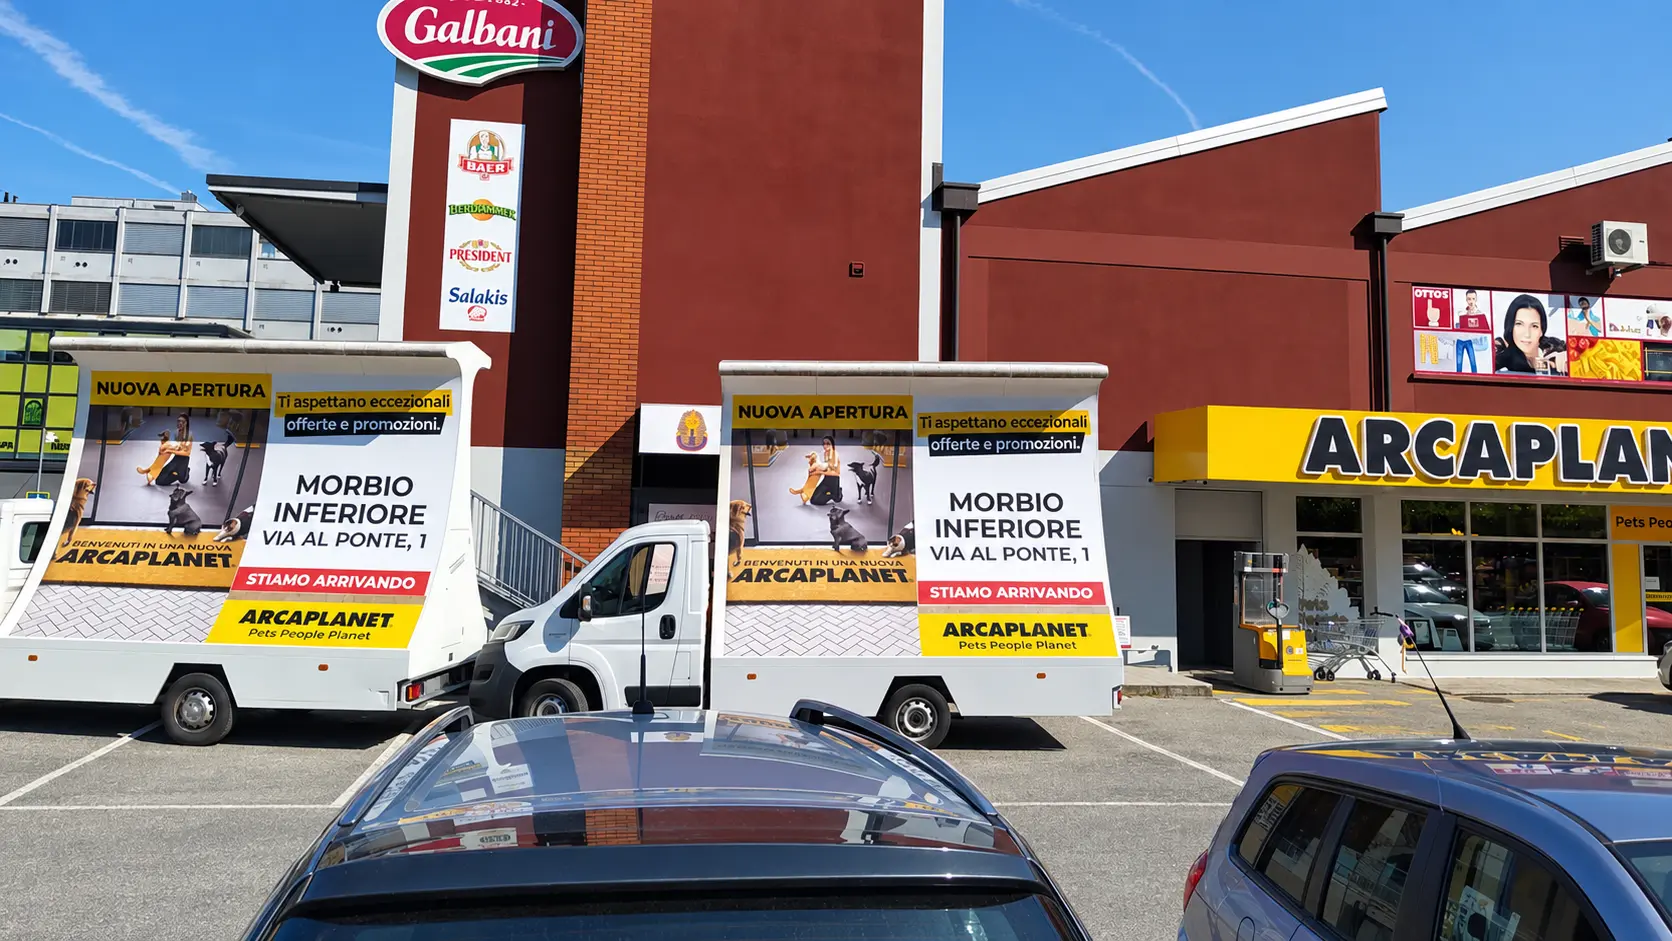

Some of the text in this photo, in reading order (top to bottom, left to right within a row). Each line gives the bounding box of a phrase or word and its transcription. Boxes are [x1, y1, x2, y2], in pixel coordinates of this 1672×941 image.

[405, 6, 556, 50] Galbani
[467, 161, 505, 173] BAER
[449, 248, 512, 263] PRESIDENT
[448, 287, 508, 305] Salakis
[97, 381, 266, 398] NUOVA APERTURA
[277, 394, 450, 411] Ti aspettano eccezionali
[738, 405, 908, 419] NUOVA APERTURA
[286, 416, 441, 434] offerte e promozioni.
[920, 415, 1088, 431] Ti aspettano eccezionali
[931, 436, 1081, 453] offerte e promozioni.
[296, 474, 414, 497] MORBIO
[950, 492, 1064, 513] MORBIO
[273, 502, 427, 525] INFERIORE
[1616, 516, 1645, 528] Pets
[935, 519, 1082, 539] INFERIORE
[72, 540, 140, 549] BENVENUTI
[159, 543, 185, 551] UNA
[187, 544, 233, 552] NUOVA
[263, 530, 427, 551] VIA AL PONTE, 1
[55, 549, 232, 568] ARCAPLANET
[744, 559, 813, 567] BENVENUTI
[816, 559, 829, 567] IN
[860, 560, 905, 568] NUOVA
[930, 546, 1089, 564] VIA AL PONTE, 1
[246, 573, 416, 589] STIAMO ARRIVANDO
[732, 568, 909, 583] ARCAPLANET
[930, 587, 1094, 599] STIAMO ARRIVANDO
[239, 610, 394, 628] ARCAPLANET
[248, 629, 370, 641] Pets People Planet
[943, 622, 1088, 637] ARCAPLANET
[959, 641, 1078, 652] Pets People Planet
